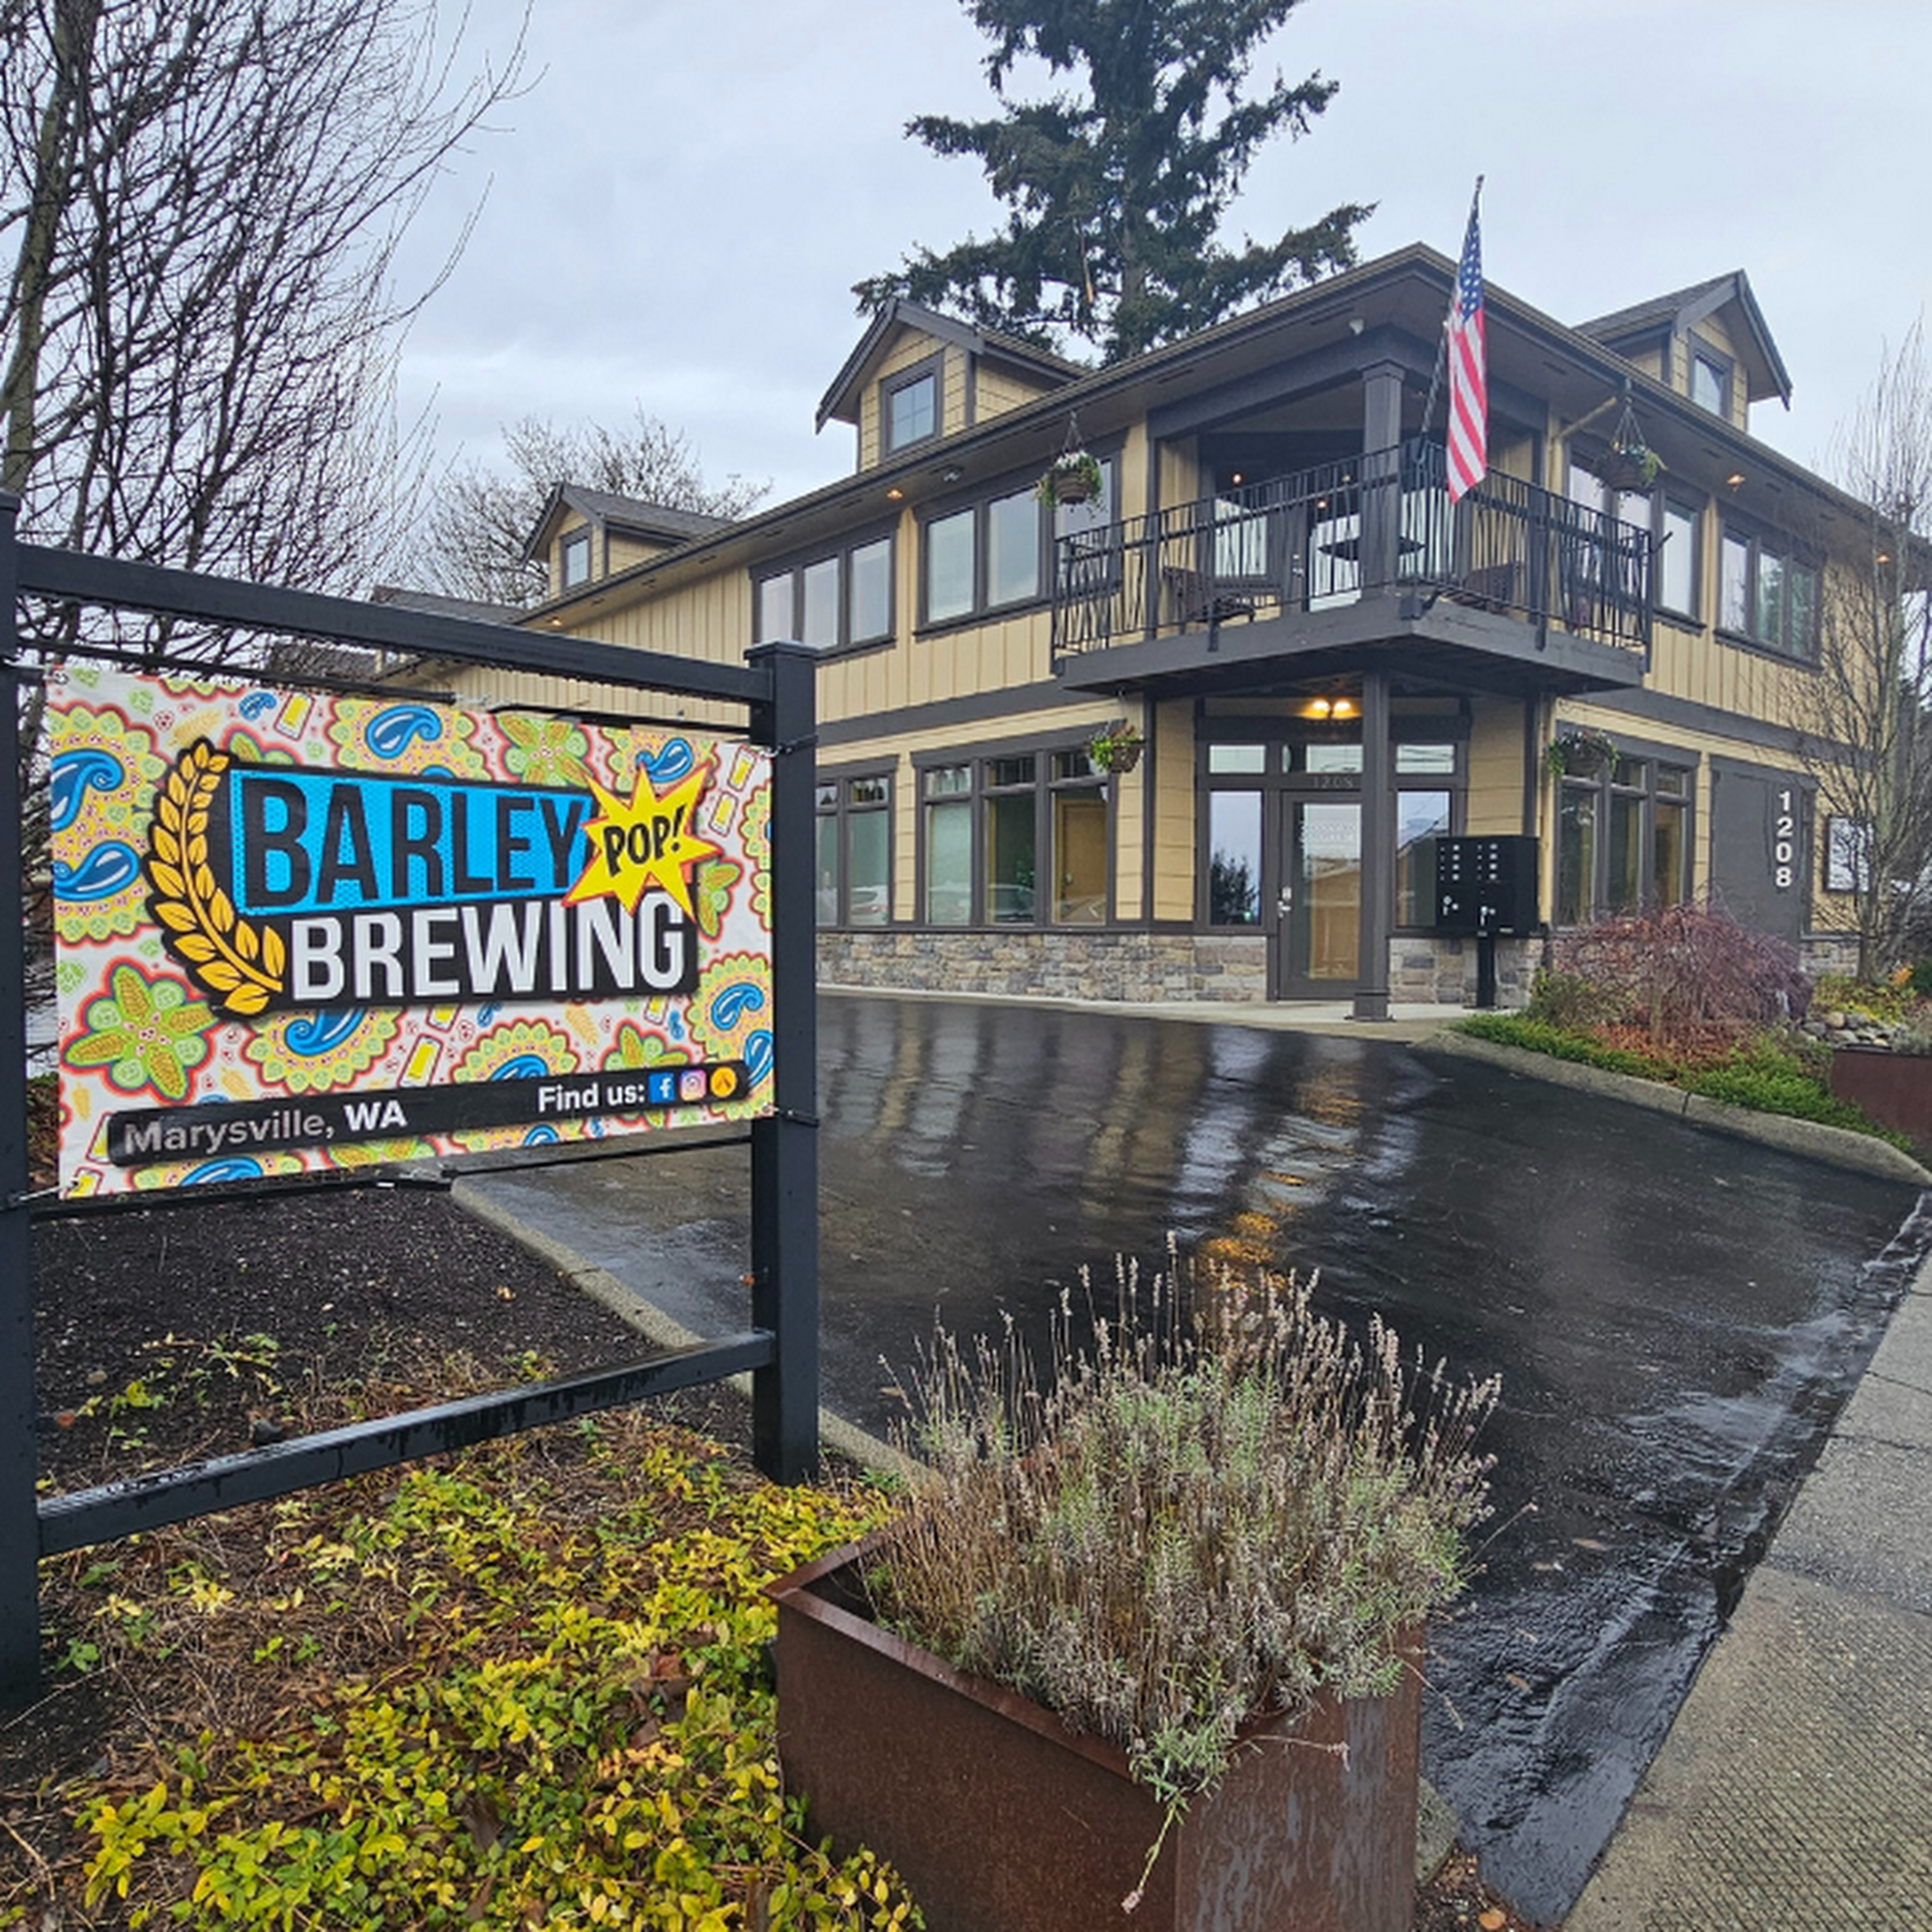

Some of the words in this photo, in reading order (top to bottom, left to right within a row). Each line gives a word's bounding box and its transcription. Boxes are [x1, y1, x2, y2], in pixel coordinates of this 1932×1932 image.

[241, 777, 583, 908] BARLEY
[603, 804, 687, 878] POP!
[1775, 790, 1793, 888] 1208
[292, 891, 684, 1002] BREWING
[124, 1111, 335, 1154] Marysville,
[343, 1099, 409, 1132] WA
[538, 1083, 599, 1113] Find
[607, 1083, 645, 1106] us:
